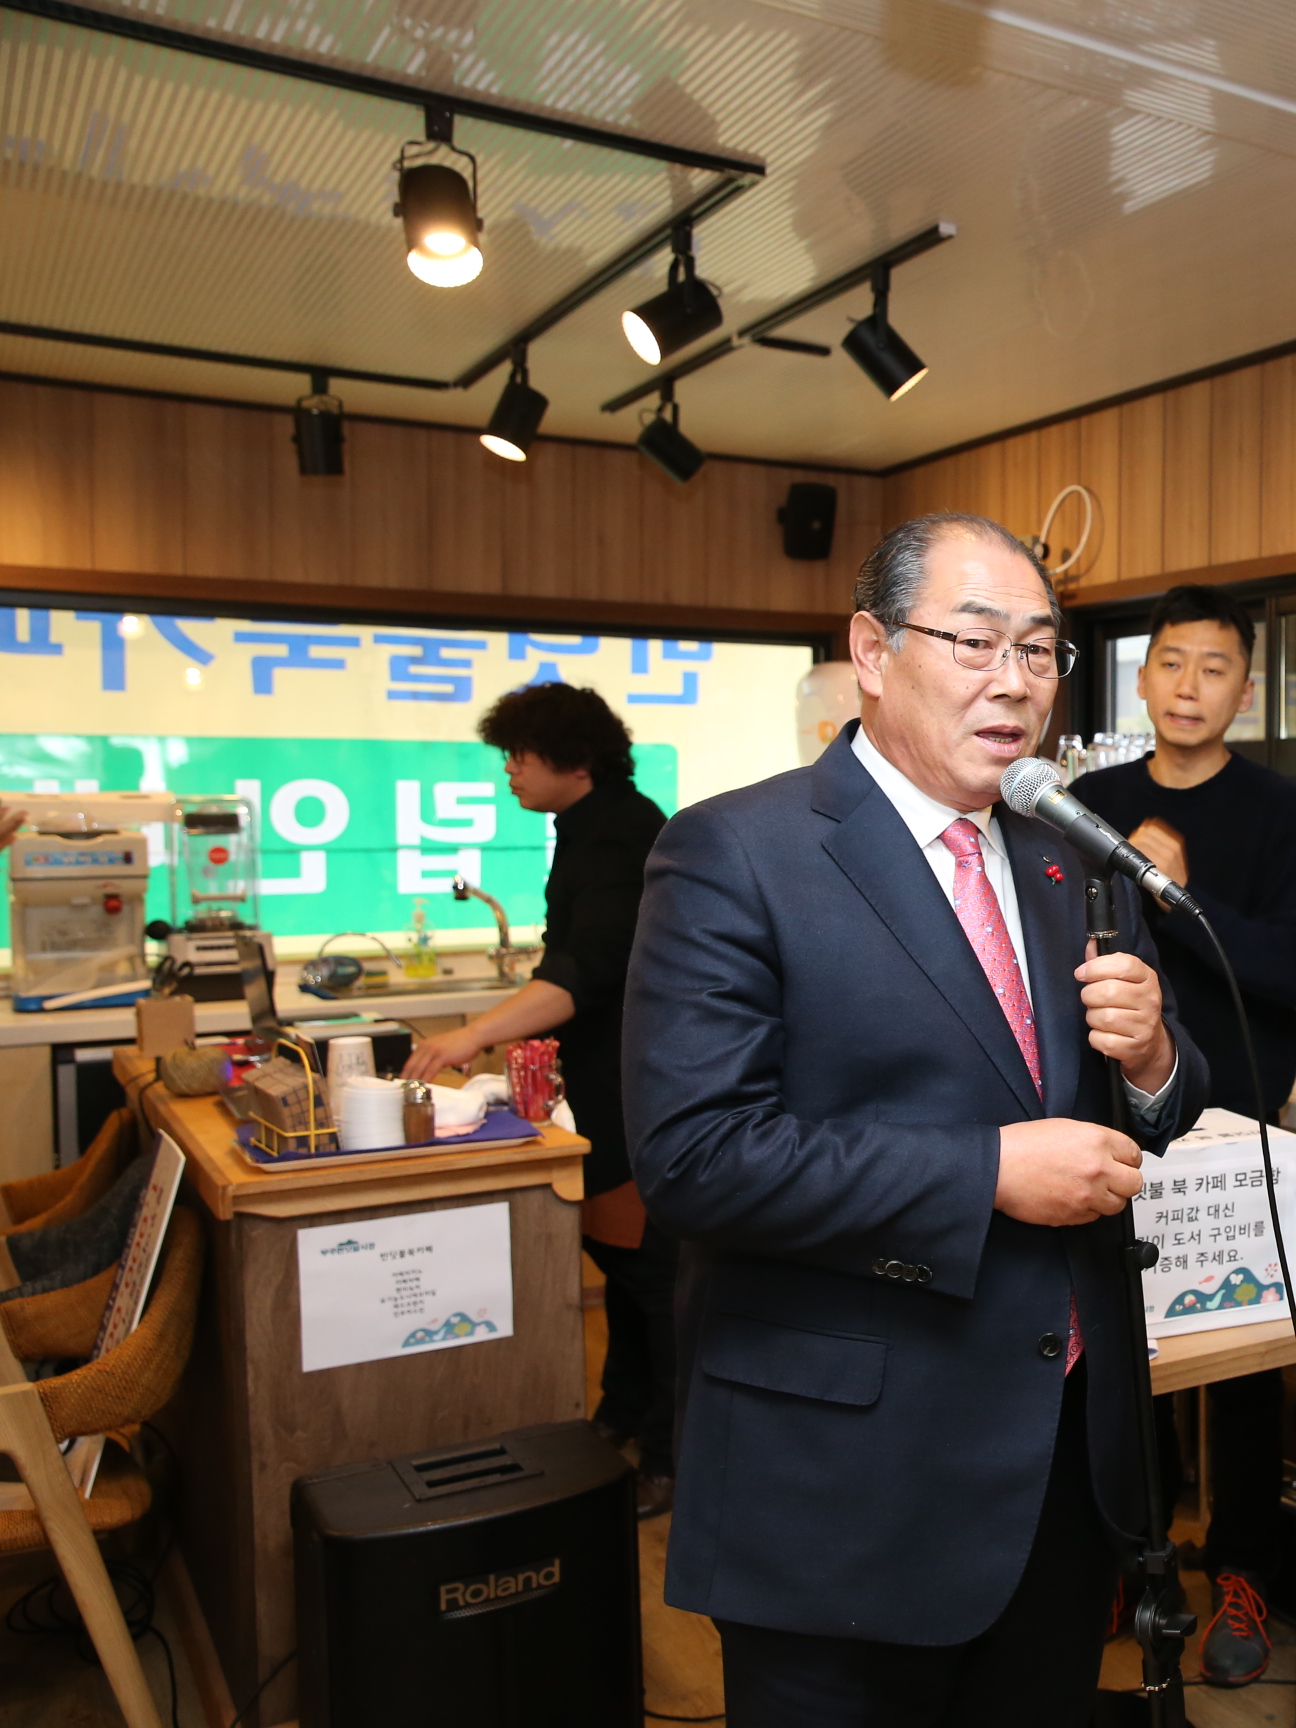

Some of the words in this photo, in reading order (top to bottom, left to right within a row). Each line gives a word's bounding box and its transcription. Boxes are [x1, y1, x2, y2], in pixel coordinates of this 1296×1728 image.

[1171, 1177, 1188, 1196] 북
[1195, 1173, 1227, 1193] 카페
[1155, 1206, 1200, 1226] 커피값
[1207, 1201, 1235, 1220] 대신
[1172, 1228, 1201, 1246] 도서
[1208, 1220, 1266, 1243] 구입비를
[1195, 1249, 1244, 1268] 주세요.
[439, 1558, 561, 1612] Roland
